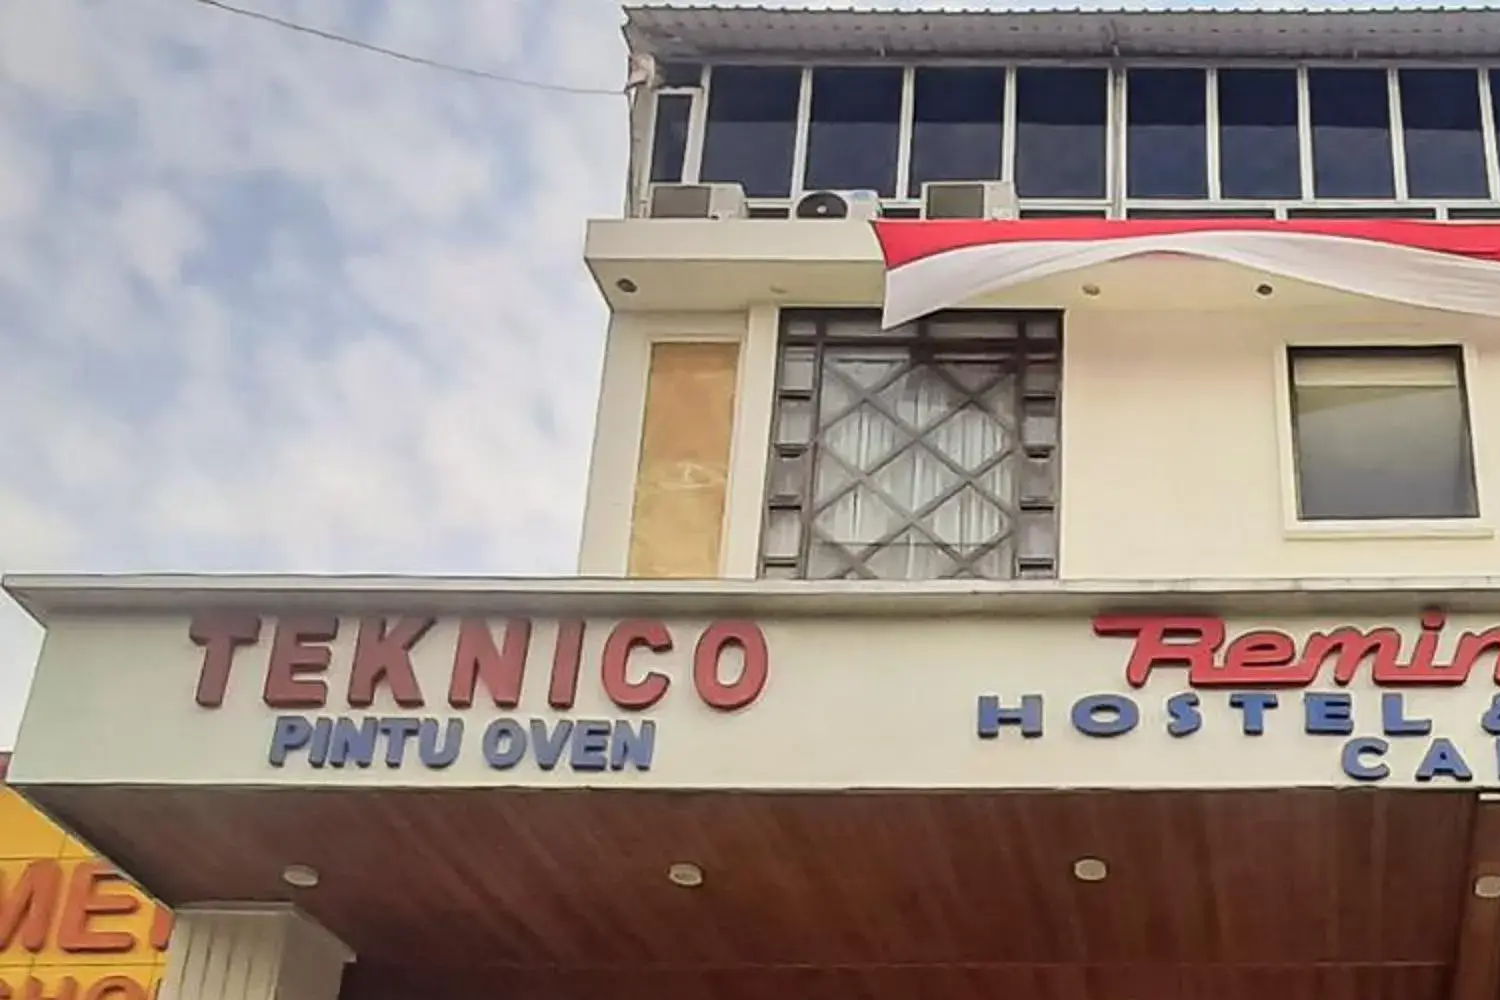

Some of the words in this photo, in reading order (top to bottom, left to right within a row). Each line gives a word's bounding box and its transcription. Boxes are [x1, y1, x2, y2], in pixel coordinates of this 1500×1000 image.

[189, 614, 769, 711] TEKNICO
[976, 692, 1433, 737] HOSTEL
[268, 715, 465, 770] PINTU
[482, 718, 657, 772] OVEN
